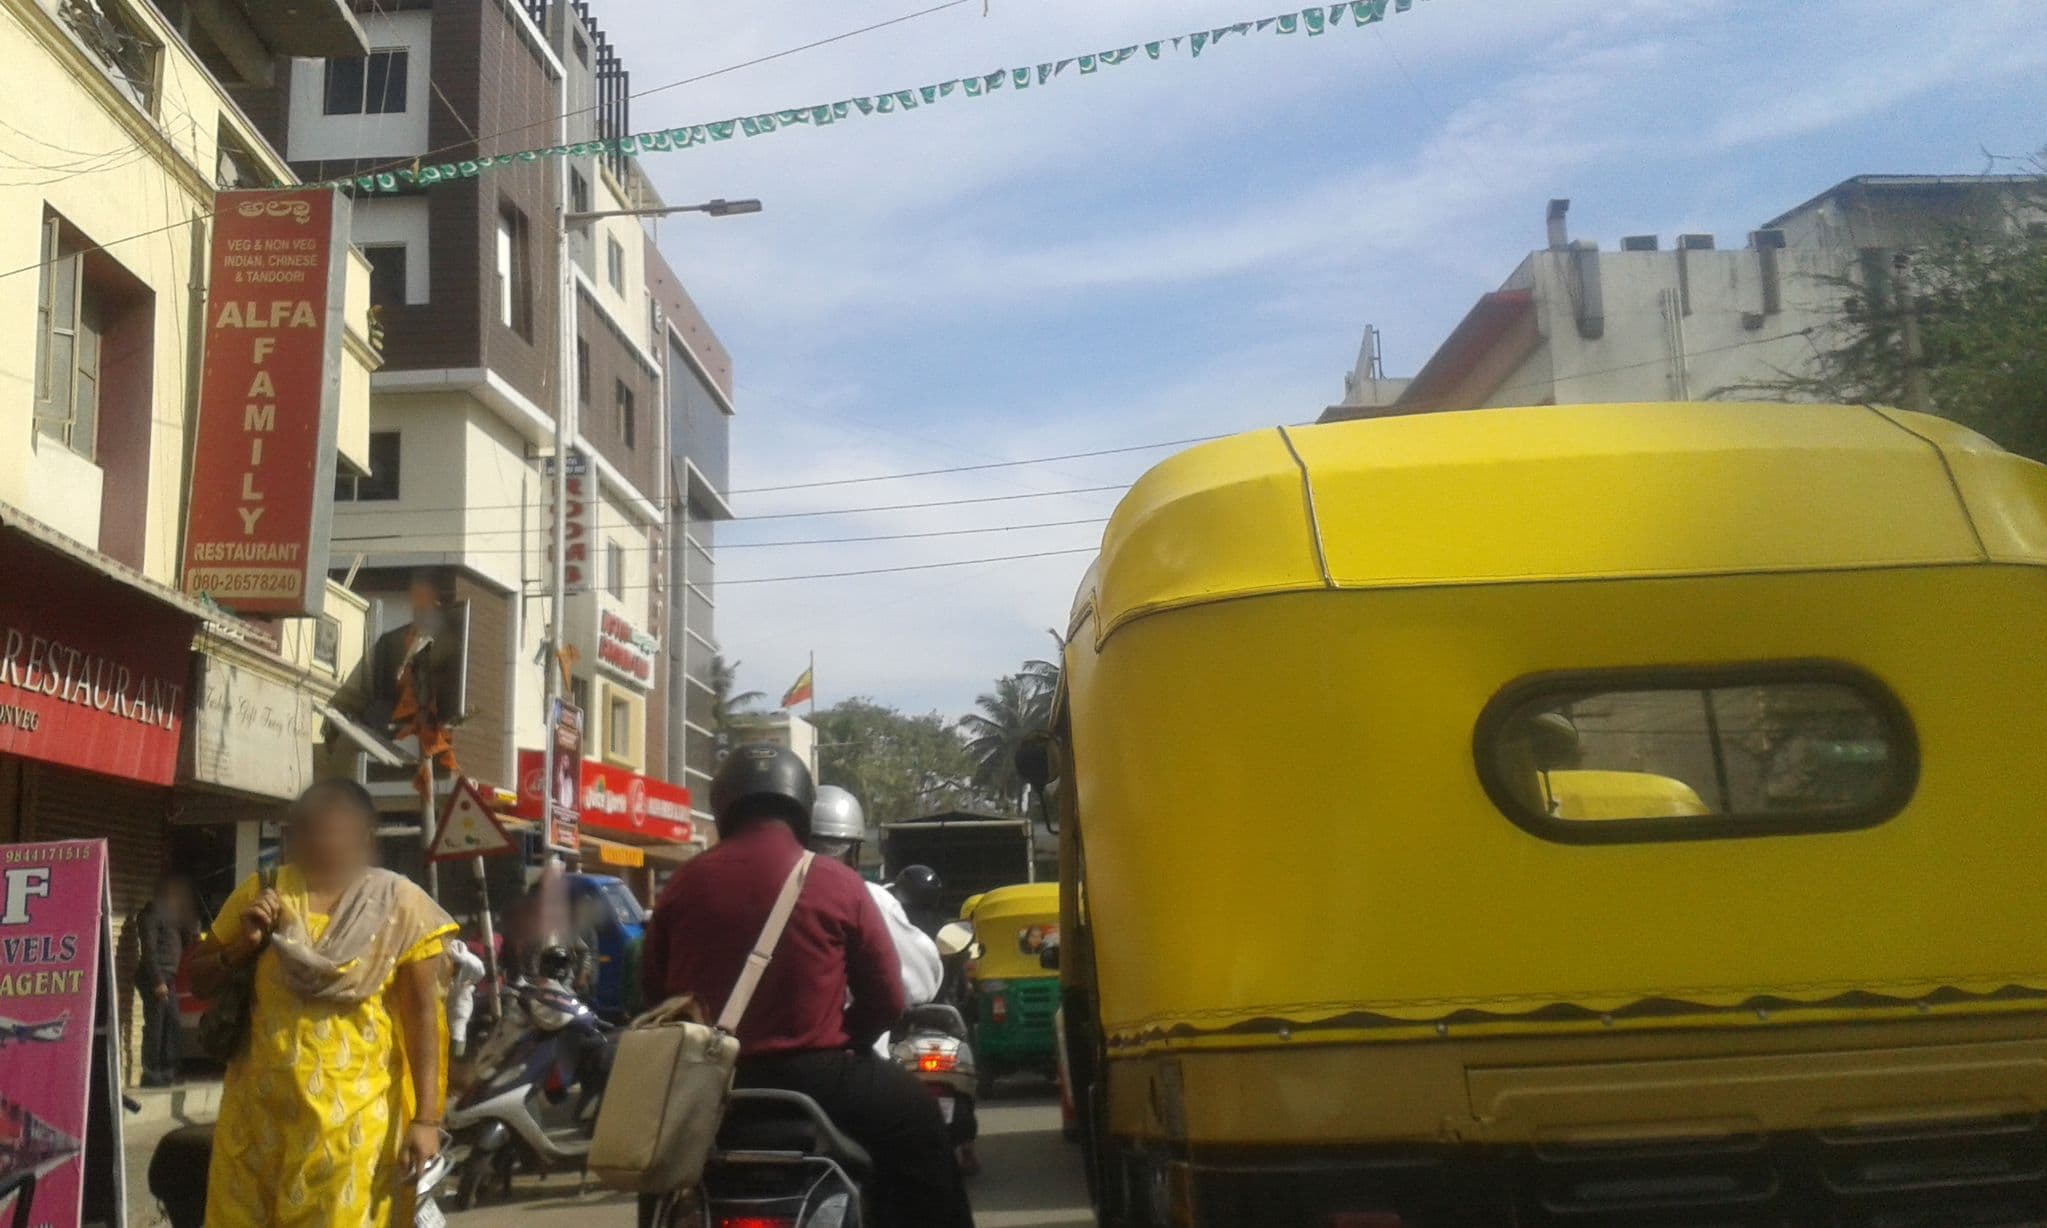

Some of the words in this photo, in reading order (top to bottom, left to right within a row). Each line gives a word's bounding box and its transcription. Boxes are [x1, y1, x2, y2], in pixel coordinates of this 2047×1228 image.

[227, 239, 252, 251] VEG
[254, 240, 263, 250] &
[265, 239, 290, 250] NON
[292, 239, 316, 250] VEG
[268, 255, 318, 266] CHINESE
[235, 272, 243, 282] &
[246, 272, 305, 282] TANDOORI
[216, 301, 317, 328] ALFA
[238, 337, 276, 535] FAMILY
[194, 543, 300, 561] RESTAURANT
[0, 628, 181, 730] RESTAURANT
[0, 970, 83, 997] AGENT
